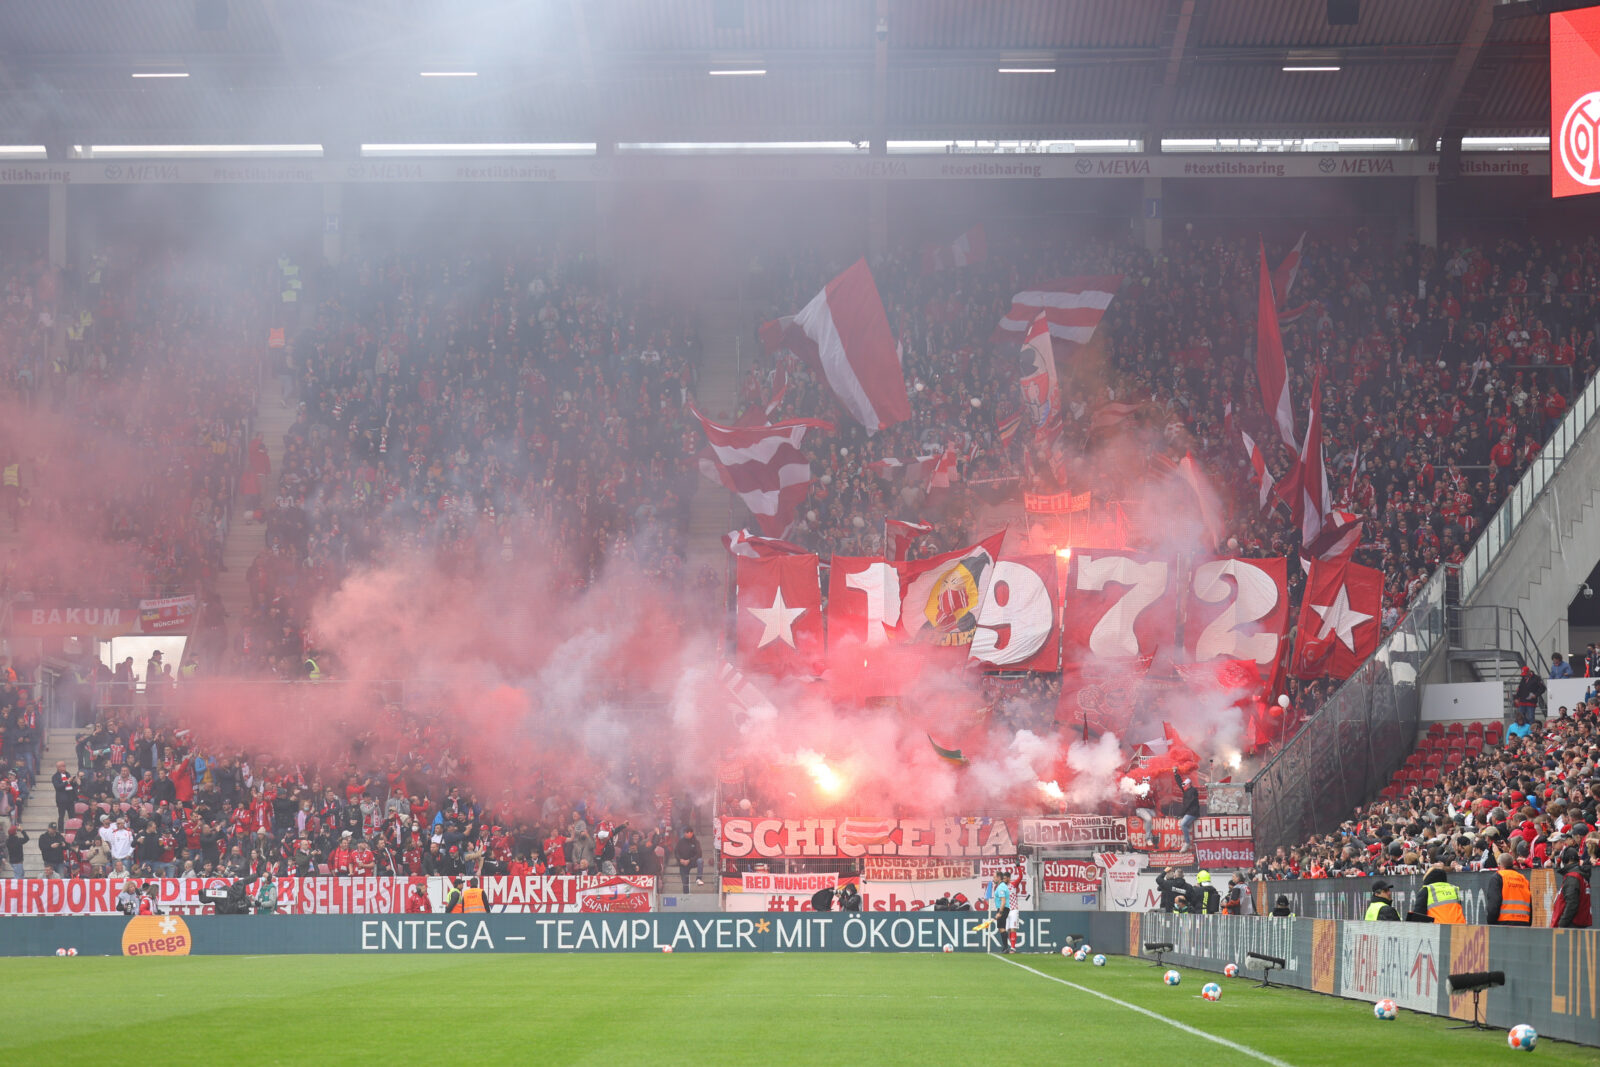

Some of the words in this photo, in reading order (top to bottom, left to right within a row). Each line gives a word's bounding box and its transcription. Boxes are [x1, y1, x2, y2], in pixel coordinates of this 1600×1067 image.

[126, 165, 181, 180] MEWA
[368, 164, 424, 179] MEWA
[853, 162, 908, 177] MEWA
[941, 162, 1042, 177] #textilsharing
[1096, 159, 1150, 174] MEWA
[1184, 162, 1285, 176] #textilsharing
[1341, 158, 1394, 173] MEWA
[1428, 160, 1529, 175] #tilsharing
[456, 166, 557, 181] #textilsharing
[32, 608, 120, 626] BAKUM
[1194, 818, 1252, 839] COLEGIO
[1002, 856, 1027, 866] SID
[865, 868, 913, 881] IMMER
[916, 868, 939, 880] BEI
[943, 866, 971, 879] UNS
[1045, 861, 1103, 881] SÜDTIROL
[442, 875, 575, 903] NMARKT
[745, 876, 771, 889] RED
[0, 878, 125, 914] HRDORF
[362, 920, 494, 950] ENTEGA
[777, 919, 833, 948] MIT
[128, 935, 186, 956] entega
